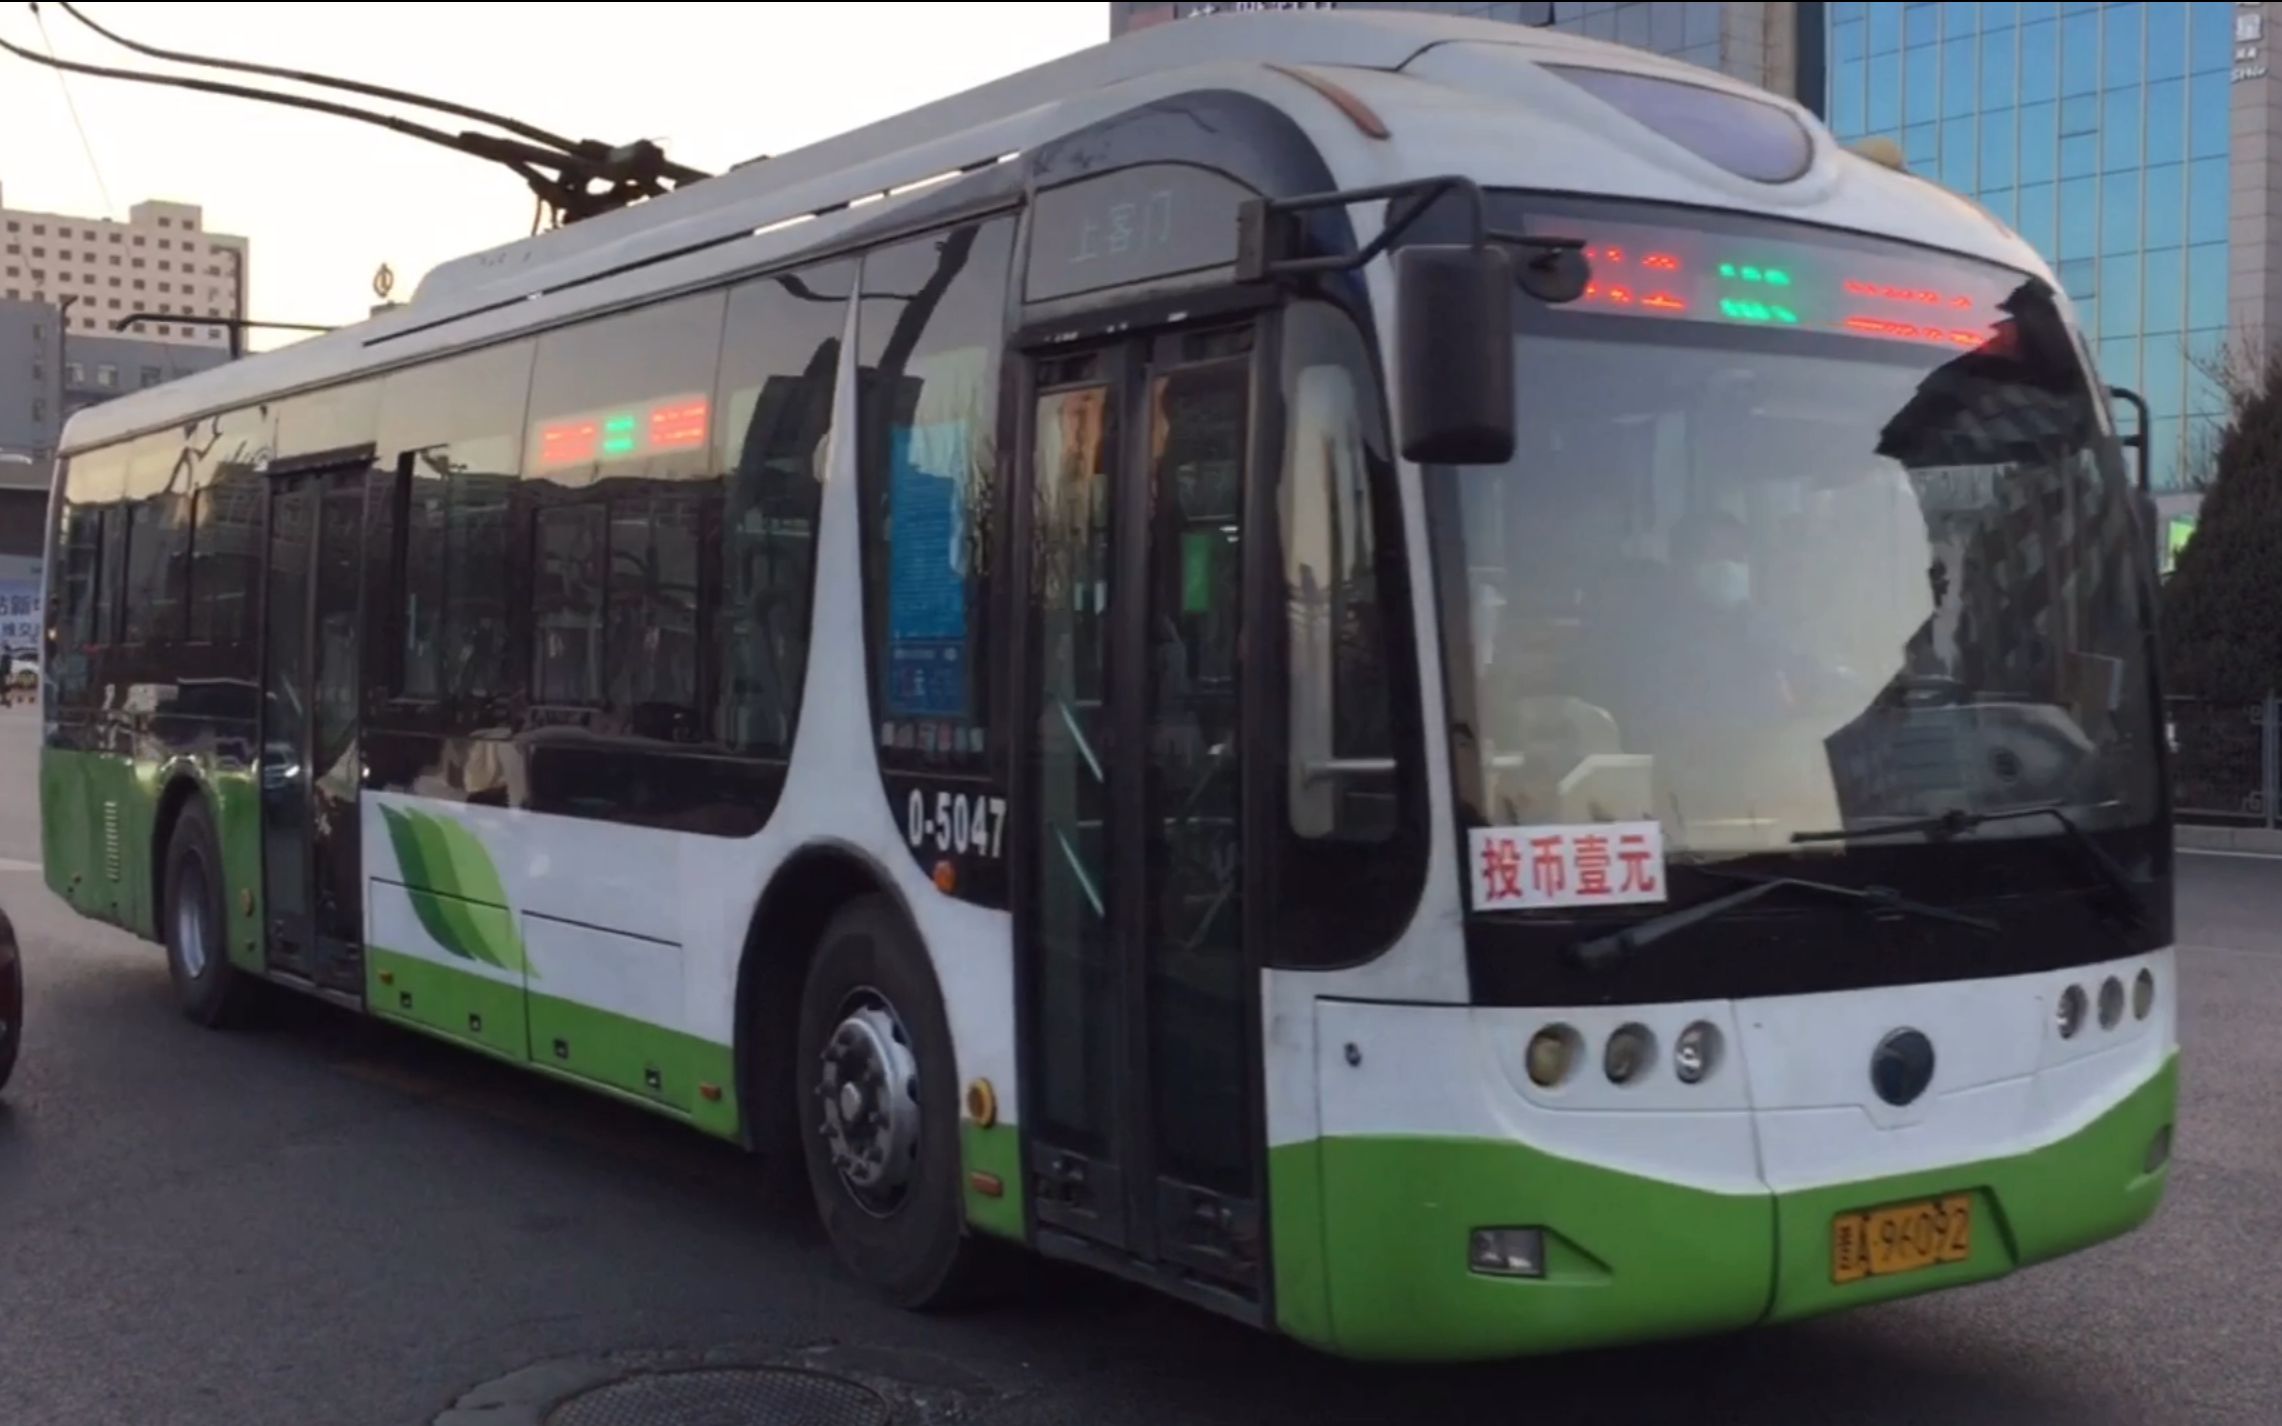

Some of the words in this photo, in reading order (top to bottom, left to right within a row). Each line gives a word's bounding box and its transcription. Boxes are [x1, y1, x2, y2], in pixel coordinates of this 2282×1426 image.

[908, 788, 1006, 858] 0-5047
[1481, 833, 1657, 901] 投币壹元
